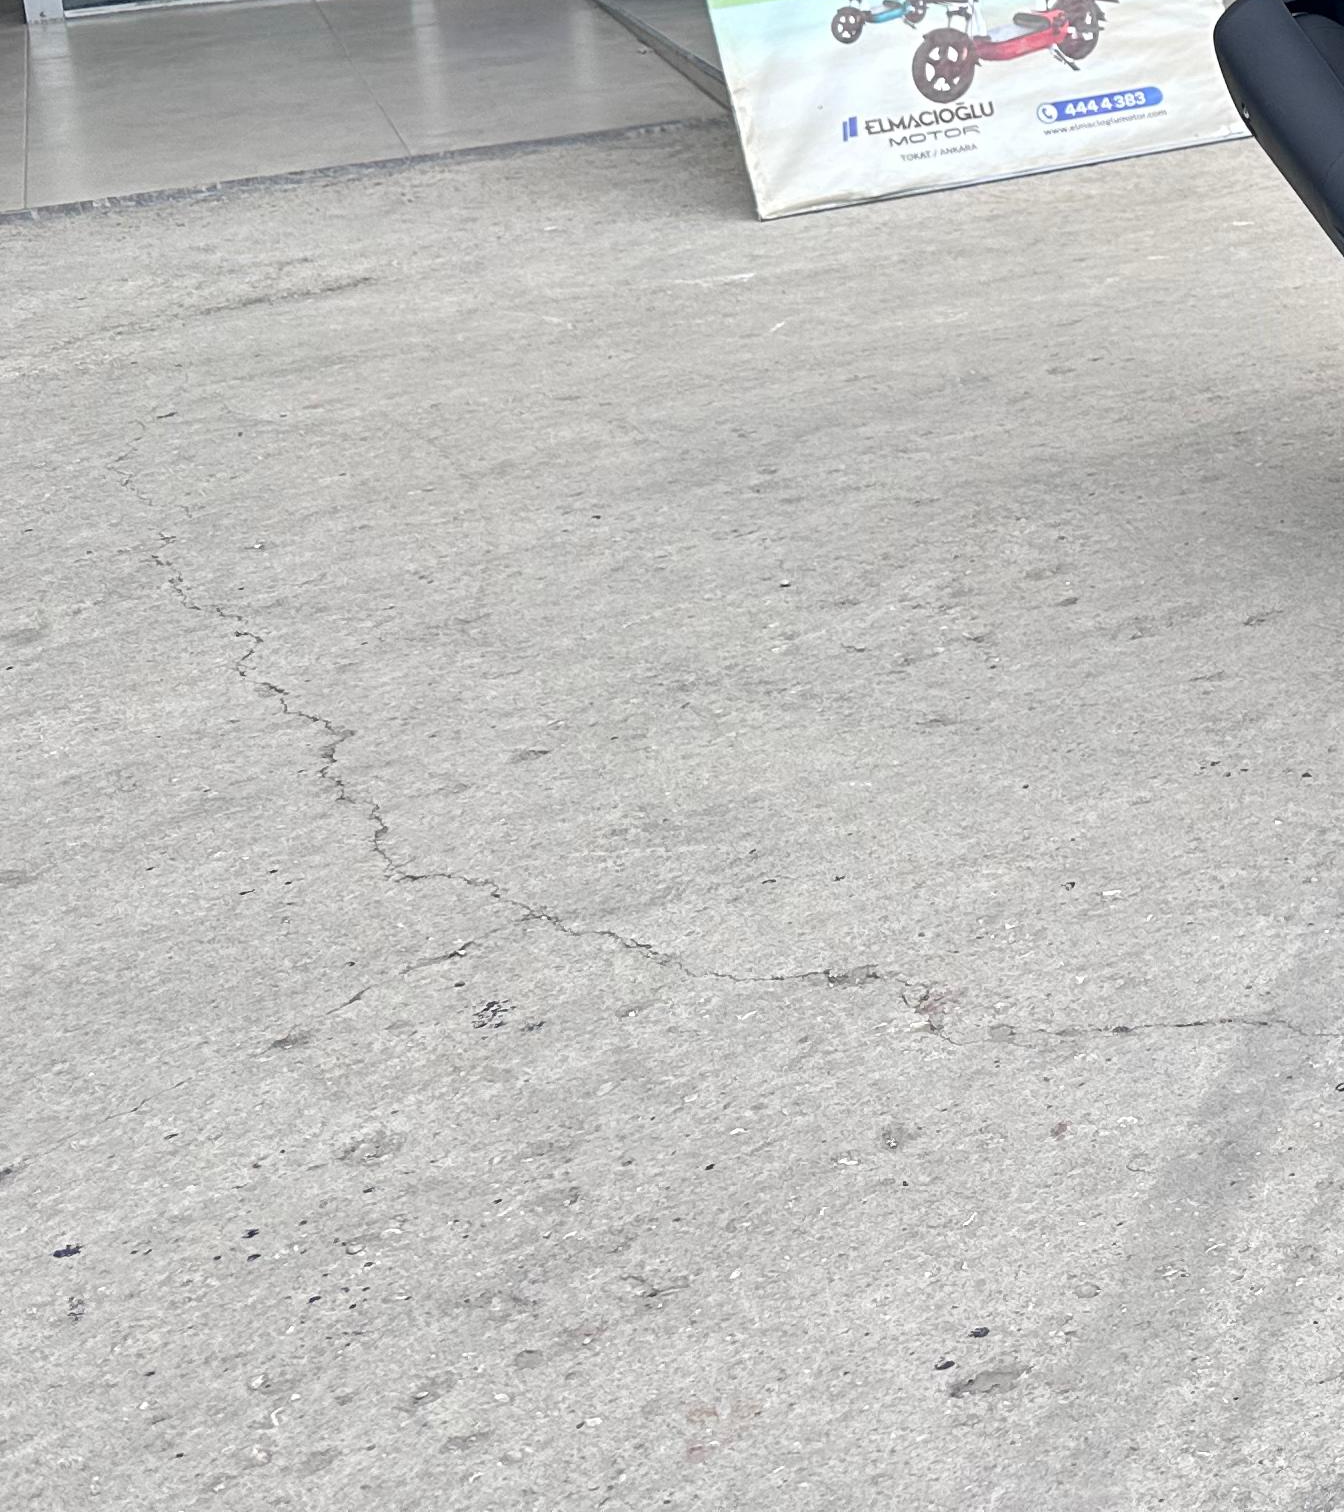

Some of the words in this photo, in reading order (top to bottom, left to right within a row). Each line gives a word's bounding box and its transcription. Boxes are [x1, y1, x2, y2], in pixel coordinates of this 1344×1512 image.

[864, 101, 995, 135] ELMACIOĞLU
[1064, 99, 1099, 117] 444
[888, 124, 981, 148] MOTOR
[900, 149, 931, 162] TOKAT
[940, 143, 978, 157] ANKARA
